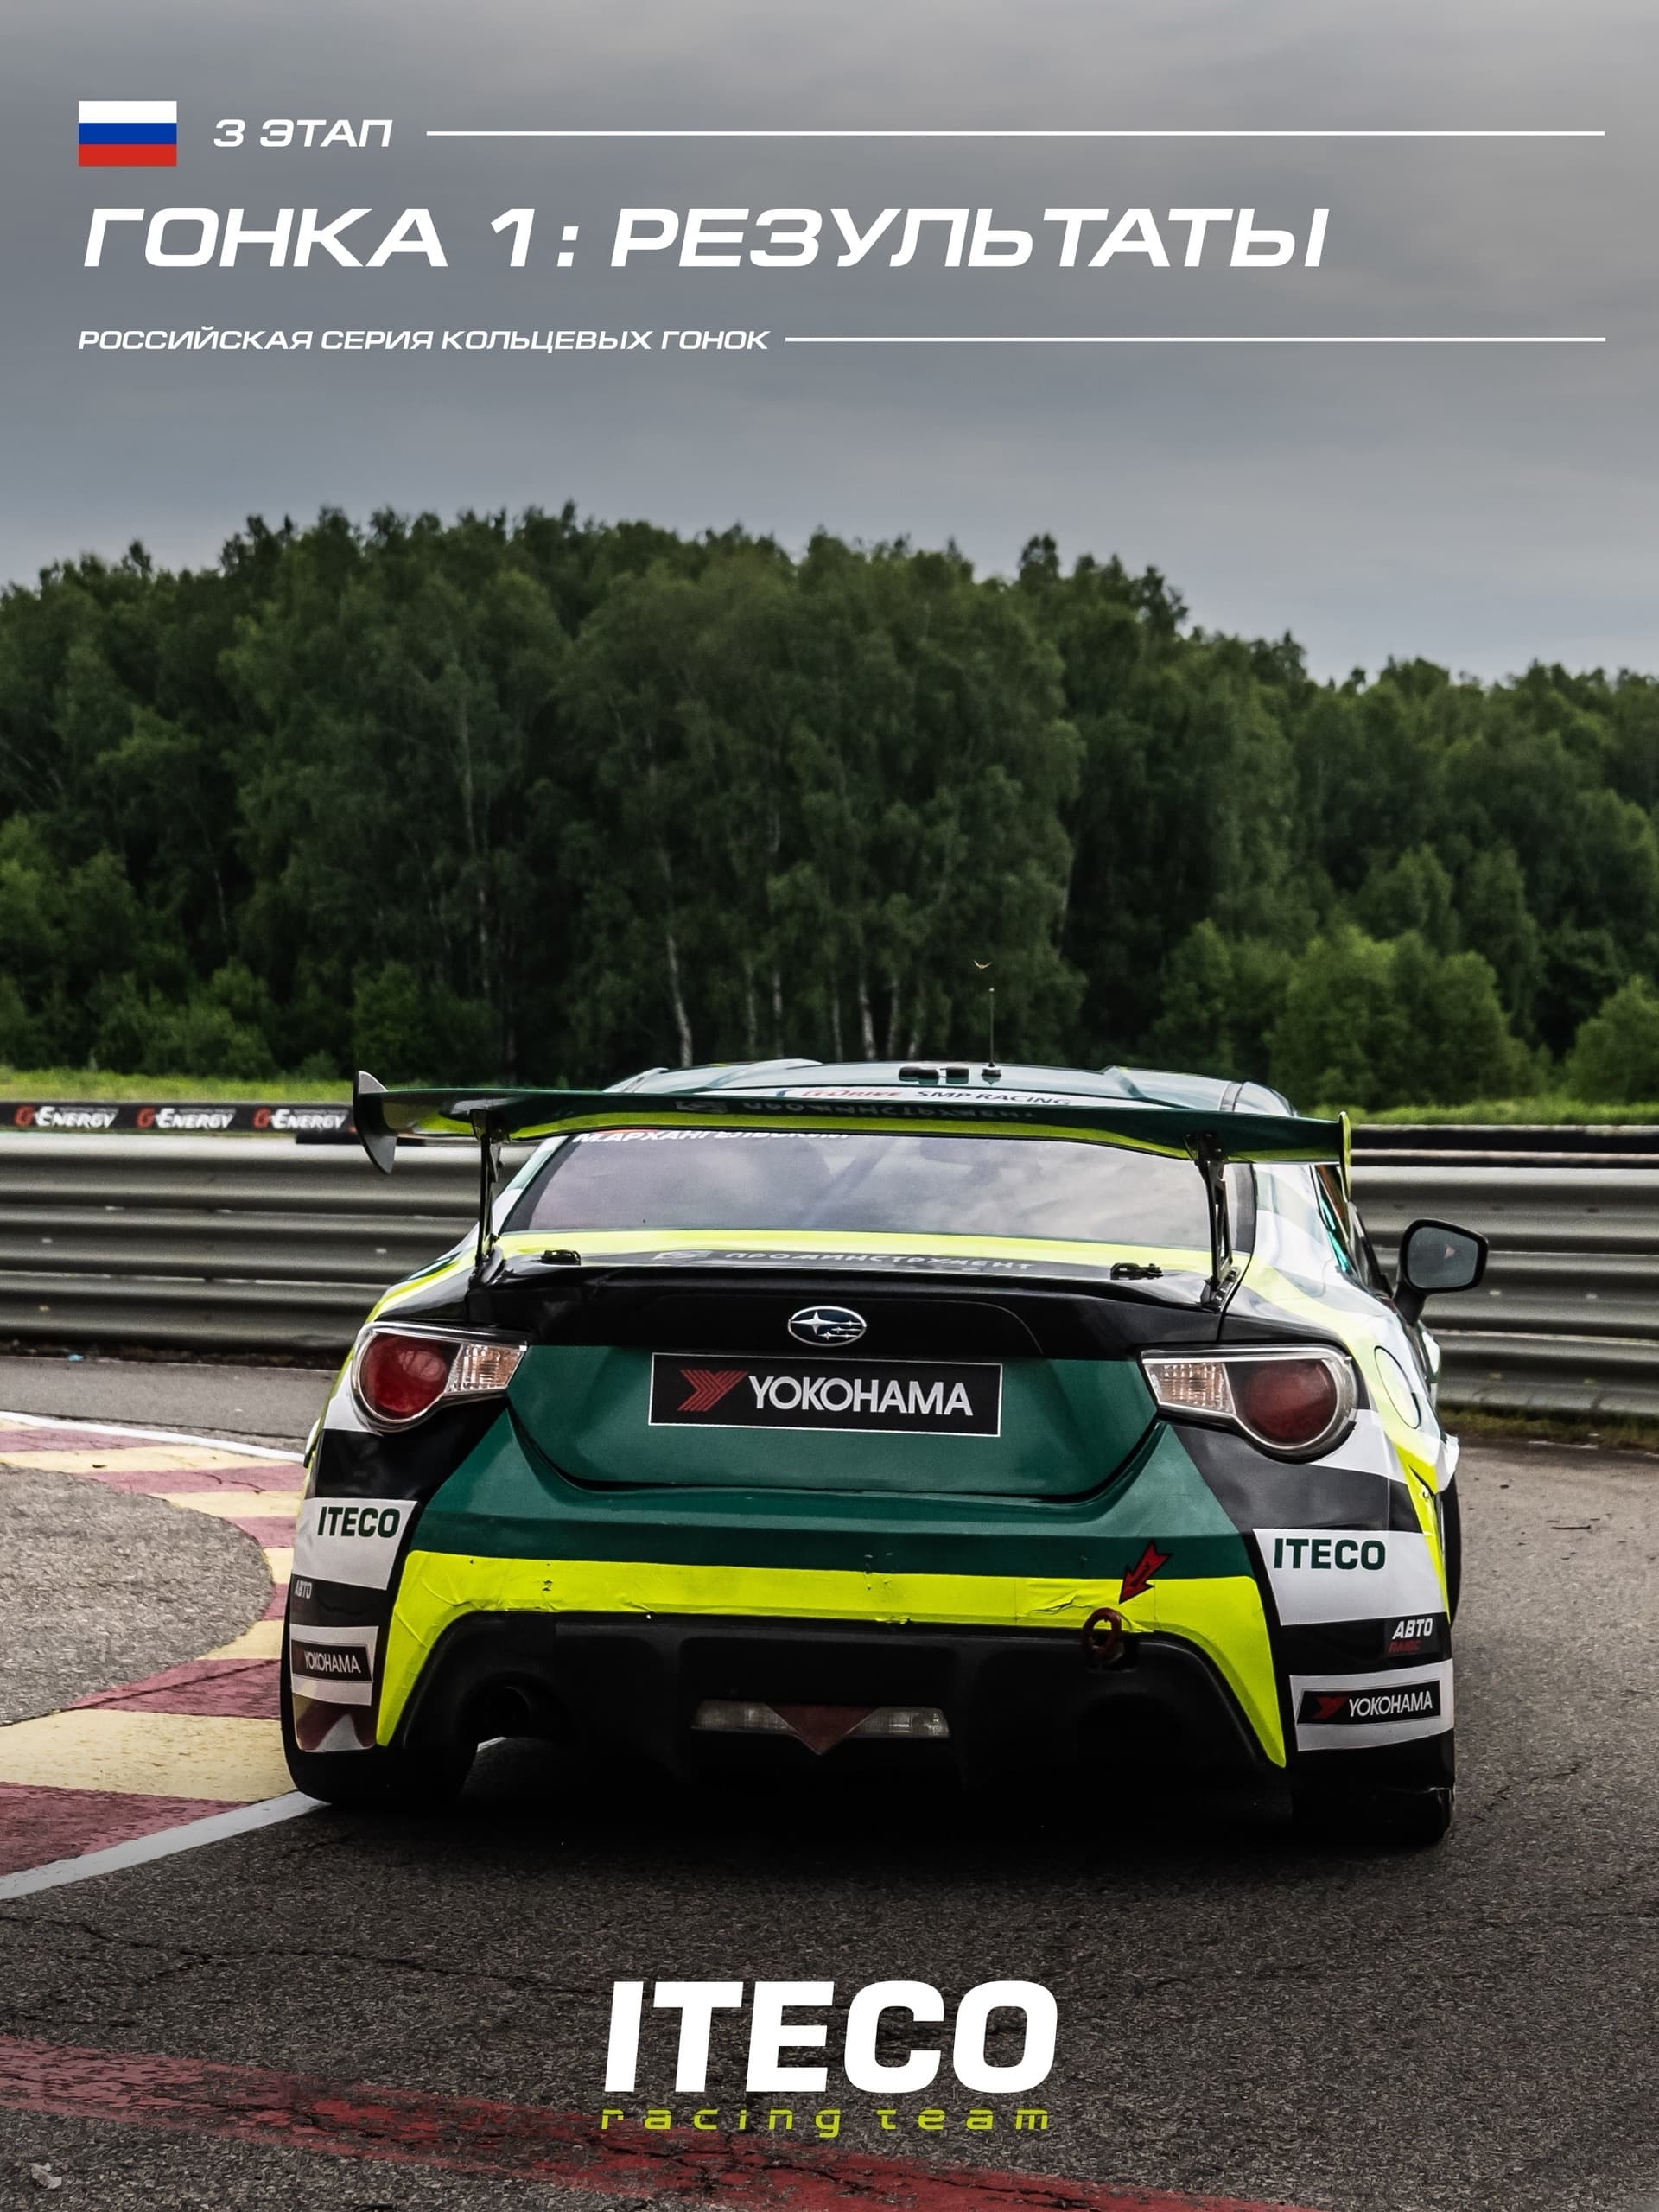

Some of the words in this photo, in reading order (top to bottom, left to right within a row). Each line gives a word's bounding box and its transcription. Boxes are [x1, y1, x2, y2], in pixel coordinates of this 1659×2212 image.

[914, 1090, 971, 1099] SMP
[978, 1093, 1072, 1105] RACING
[723, 1252, 1036, 1270] ПРОМИНСТРУМЕНТ
[748, 1375, 974, 1417] YOKOHAMA
[317, 1506, 401, 1538] ITECO
[1273, 1537, 1386, 1570] ITECO
[1391, 1618, 1433, 1640] АВТО
[302, 1649, 361, 1674] YOKOHAMA
[1348, 1690, 1433, 1718] YOKOHAMA
